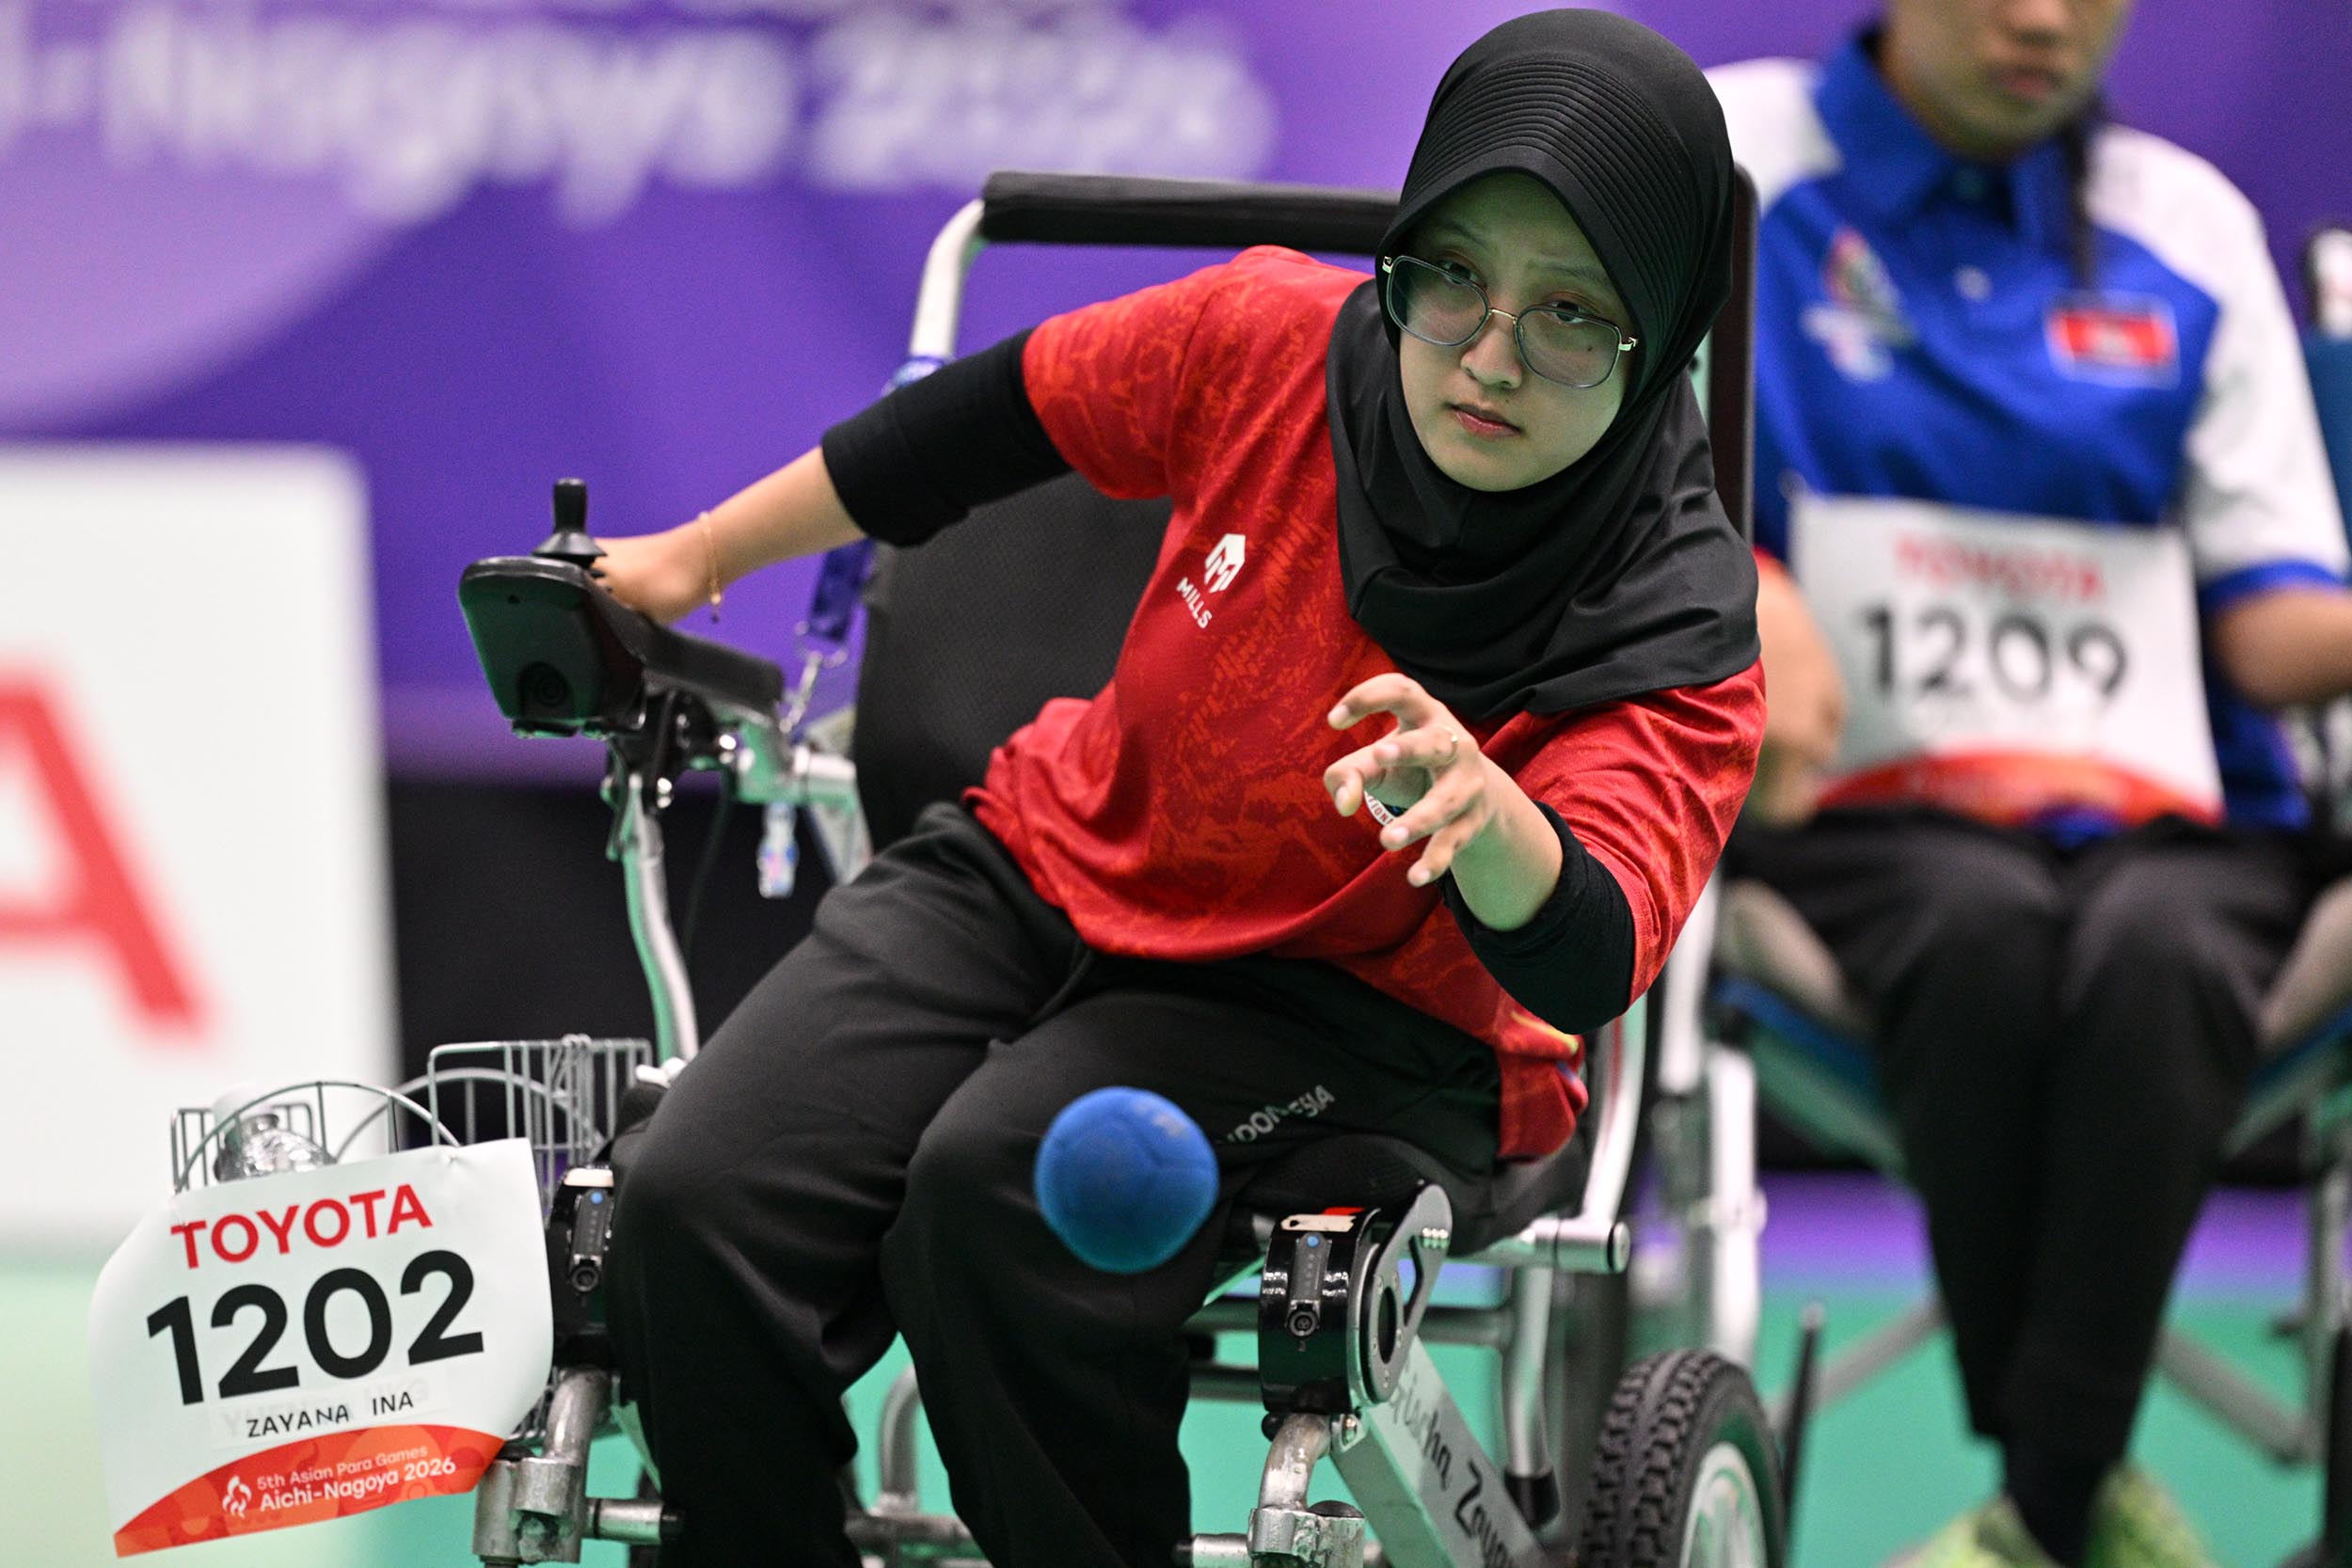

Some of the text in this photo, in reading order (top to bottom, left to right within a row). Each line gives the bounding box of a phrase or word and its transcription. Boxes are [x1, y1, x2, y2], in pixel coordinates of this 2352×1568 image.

[1176, 577, 1213, 629] MILLS
[1859, 602, 2128, 705] 1209
[170, 1183, 434, 1270] TOYOTA
[147, 1249, 485, 1406] 1202
[246, 1391, 414, 1438] ZAYANA INA
[257, 1446, 428, 1491] 5th Asian Para Games
[260, 1456, 456, 1513] Aichi-Nagoya 2026
